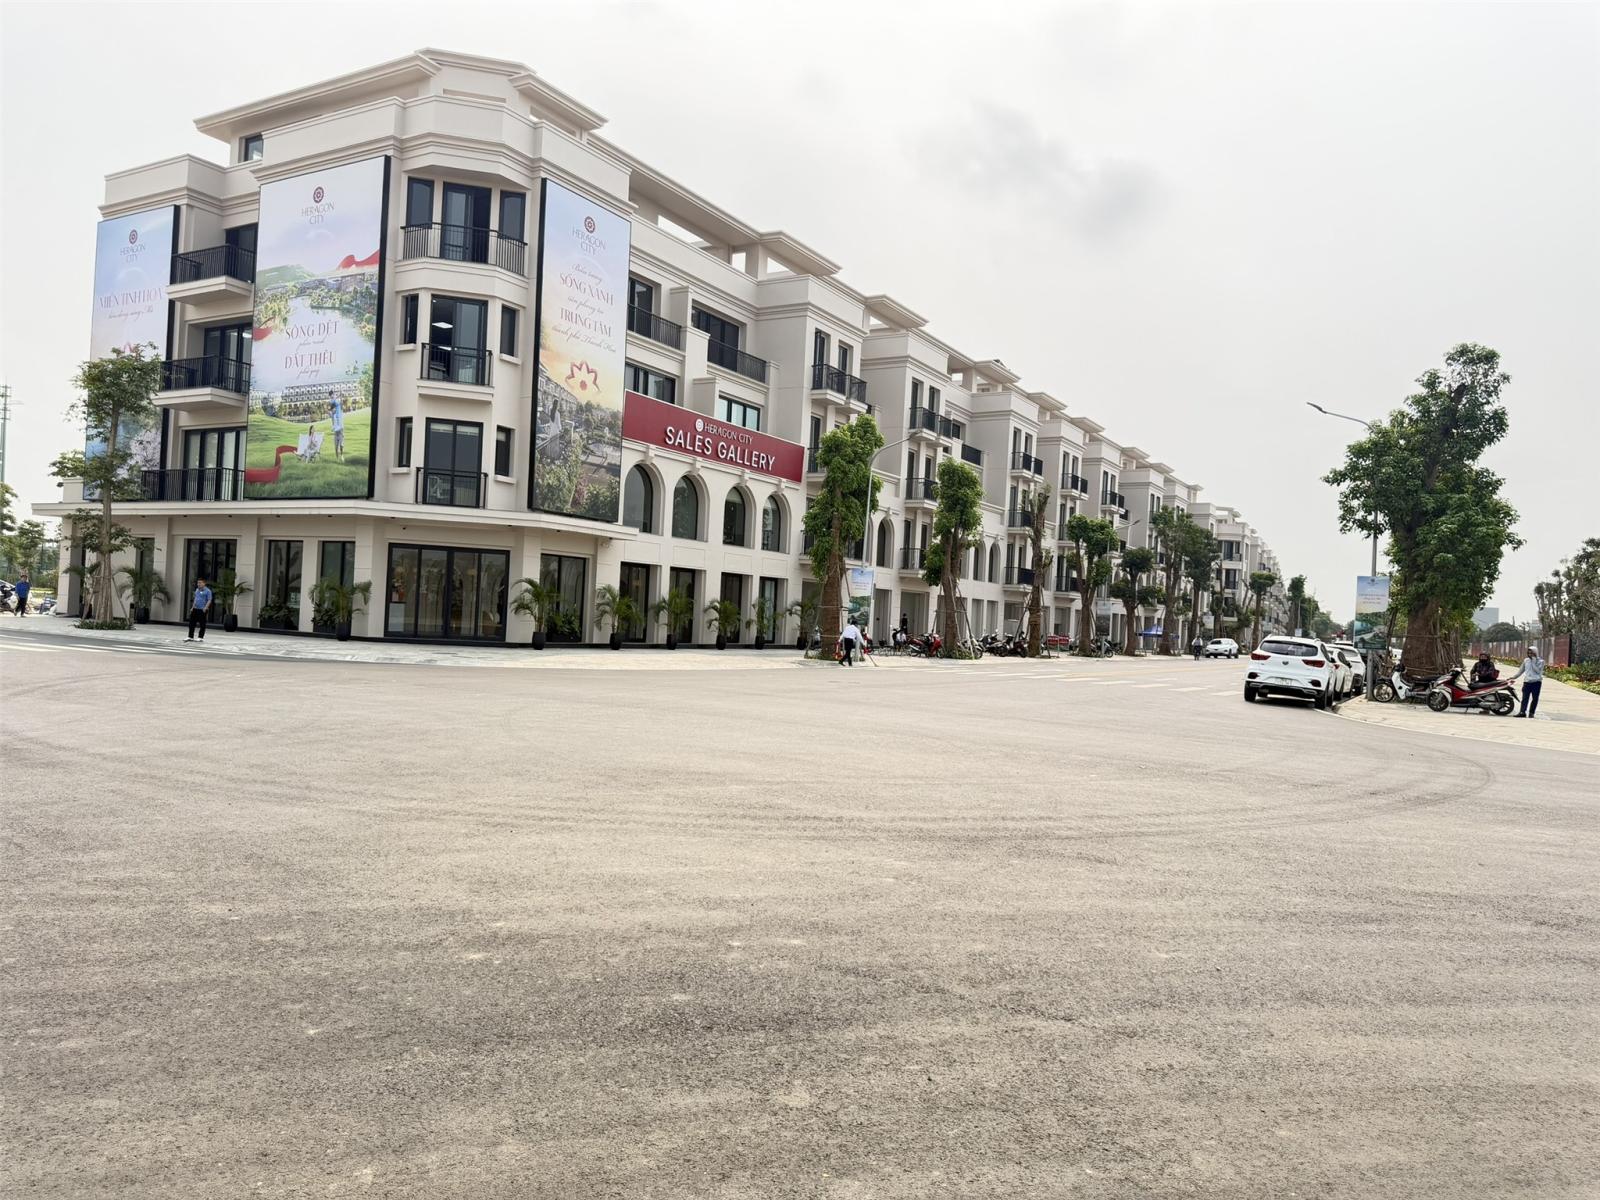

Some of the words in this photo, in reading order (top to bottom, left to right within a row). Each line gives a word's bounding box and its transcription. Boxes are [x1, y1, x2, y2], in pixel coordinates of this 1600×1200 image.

[302, 201, 335, 217] HERAGON
[309, 214, 325, 225] CITY
[572, 226, 607, 250] HERAGON
[580, 240, 597, 256] CITY
[588, 283, 614, 306] XANH
[560, 307, 591, 330] TRUNG
[704, 422, 738, 441] HERAGON
[738, 433, 753, 446] CITY
[665, 426, 712, 455] SALES
[717, 441, 775, 472] GALLERY
